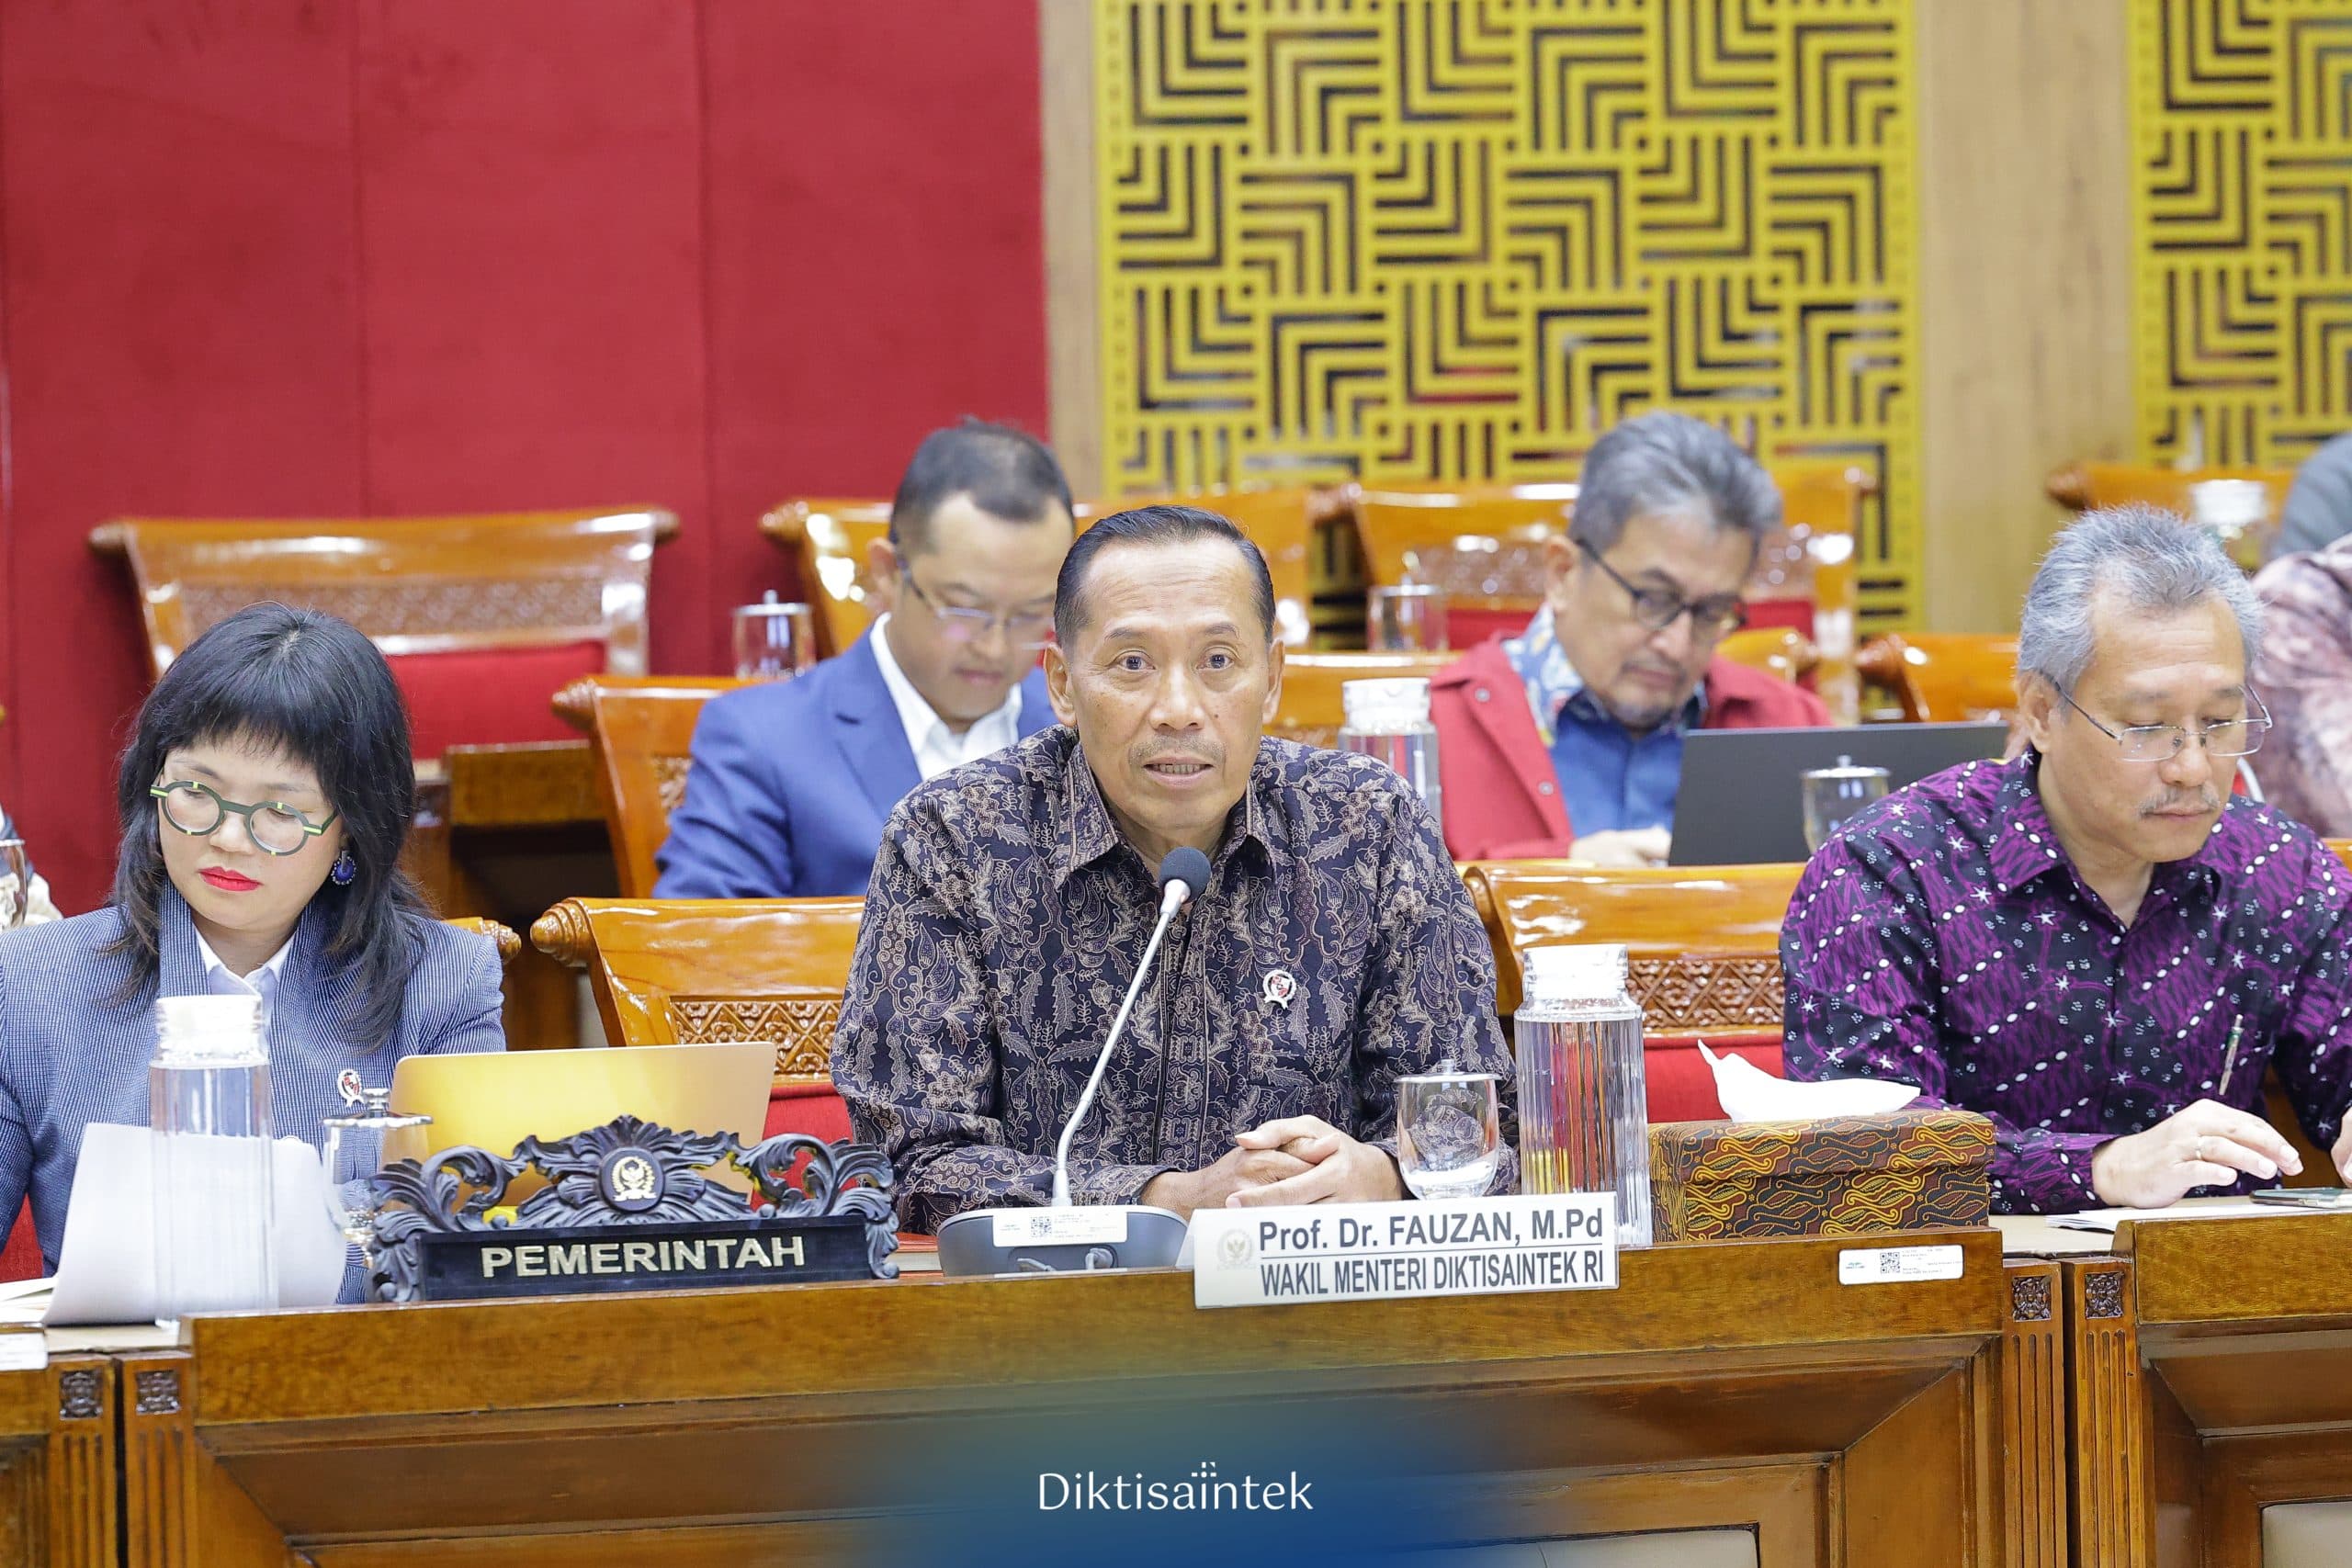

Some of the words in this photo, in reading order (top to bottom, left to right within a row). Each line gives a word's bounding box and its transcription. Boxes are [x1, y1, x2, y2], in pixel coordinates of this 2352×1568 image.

[1260, 1220, 1328, 1251] Prof.
[1340, 1218, 1378, 1248] Dr.
[1389, 1213, 1521, 1247] FAUZAN,
[1532, 1208, 1602, 1240] M.Pd
[481, 1235, 805, 1278] PEMERINTAH
[1261, 1262, 1329, 1297] WAKIL
[1334, 1258, 1427, 1294] MENTERI
[1433, 1251, 1577, 1290] DIKTISAINTEK
[1584, 1249, 1603, 1283] RI
